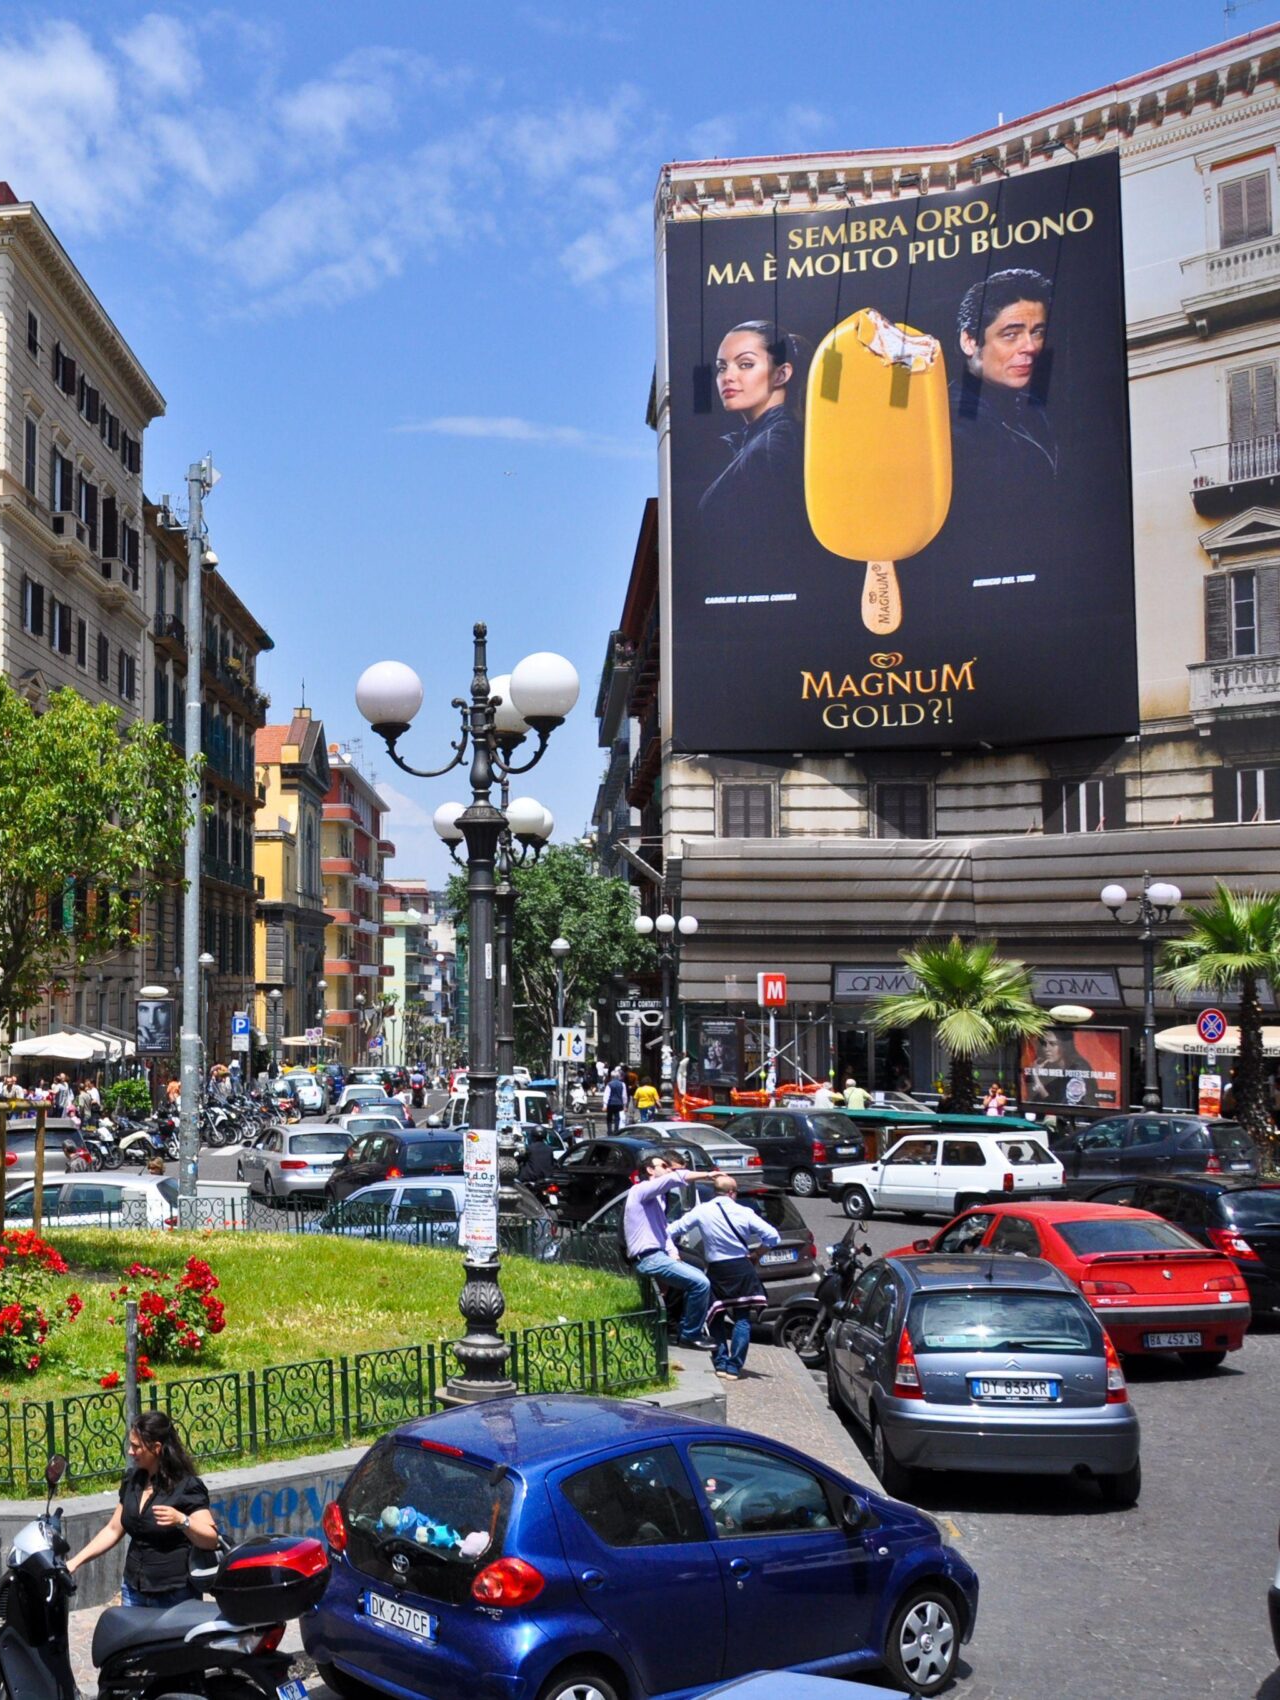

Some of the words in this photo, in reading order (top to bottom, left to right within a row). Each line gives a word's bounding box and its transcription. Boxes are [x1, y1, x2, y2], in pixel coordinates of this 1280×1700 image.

[788, 216, 908, 250] SEMBRA
[916, 200, 997, 232] ORO,
[706, 264, 755, 287] MA
[763, 254, 777, 281] È
[787, 245, 899, 279] MOLTO
[908, 226, 960, 265] PIÙ
[971, 207, 1094, 254] BUONO
[876, 572, 891, 625] MAGNUM
[800, 660, 976, 700] MAGNUM
[822, 697, 953, 730] GOLD?!
[617, 1000, 631, 1008] LENTI
[632, 1000, 636, 1008] A
[767, 981, 783, 999] M
[235, 1019, 246, 1033] P
[1150, 1333, 1162, 1345] BA
[1167, 1333, 1185, 1346] 452
[1188, 1332, 1201, 1345] WS
[982, 1380, 998, 1395] DY
[1004, 1380, 1048, 1395] 833KR
[371, 1596, 386, 1619] DK
[389, 1603, 429, 1634] 257CF
